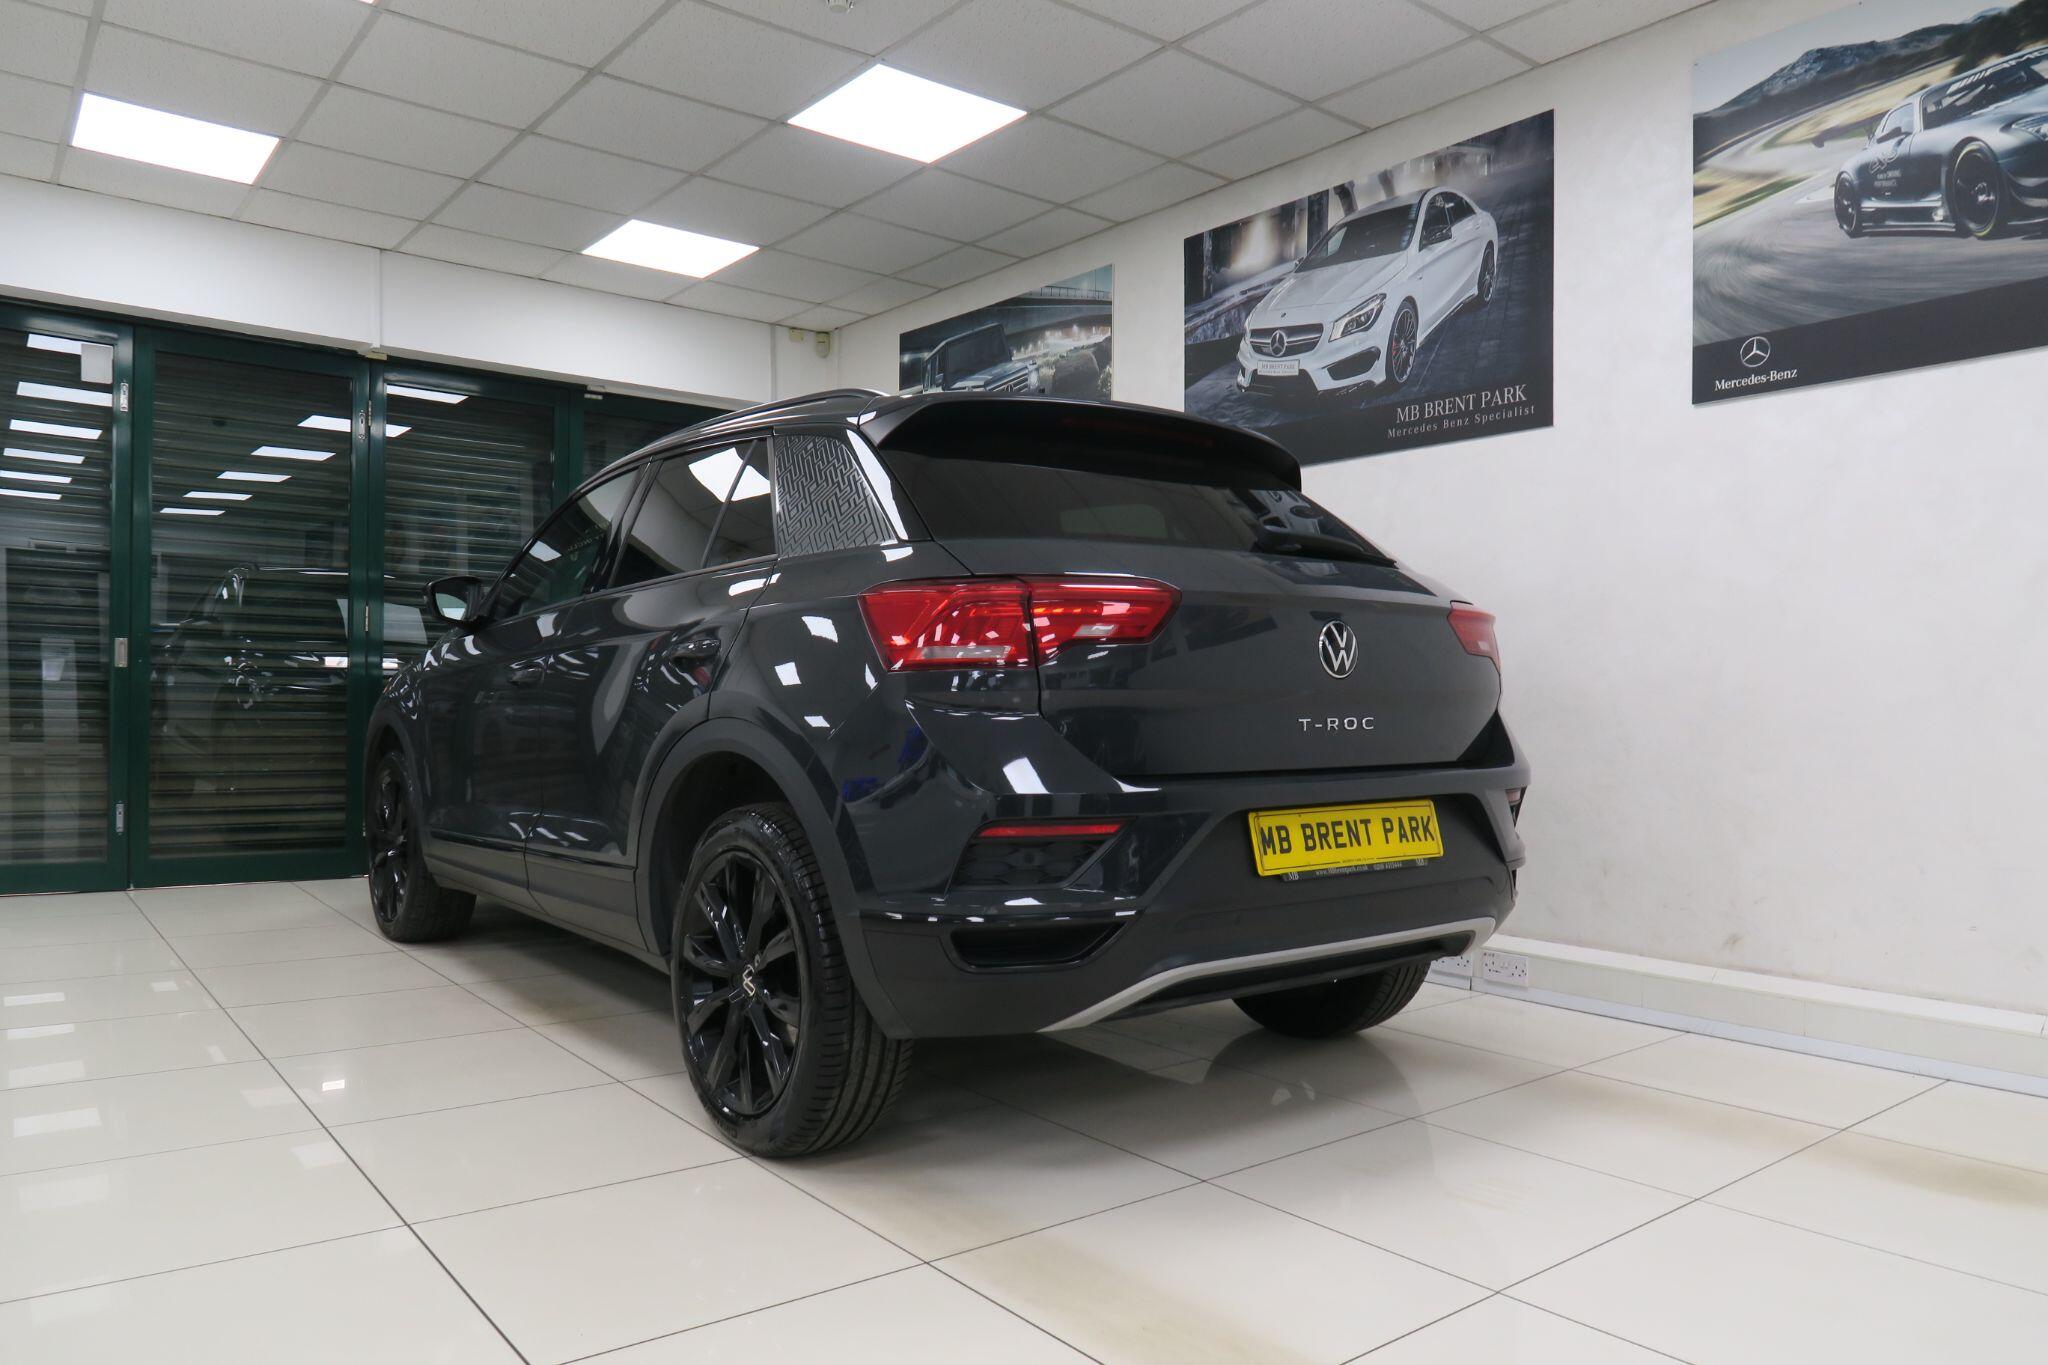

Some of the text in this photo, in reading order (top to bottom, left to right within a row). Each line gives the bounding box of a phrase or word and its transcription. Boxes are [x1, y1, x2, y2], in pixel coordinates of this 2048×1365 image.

[1714, 369, 1798, 391] Mercedes-Benz
[1396, 384, 1528, 424] MB BRENT PARK
[1387, 405, 1535, 438] Mercedes Benz Specialist
[1298, 717, 1375, 731] T-ROC
[1260, 815, 1435, 856] MB BRENT PARK
